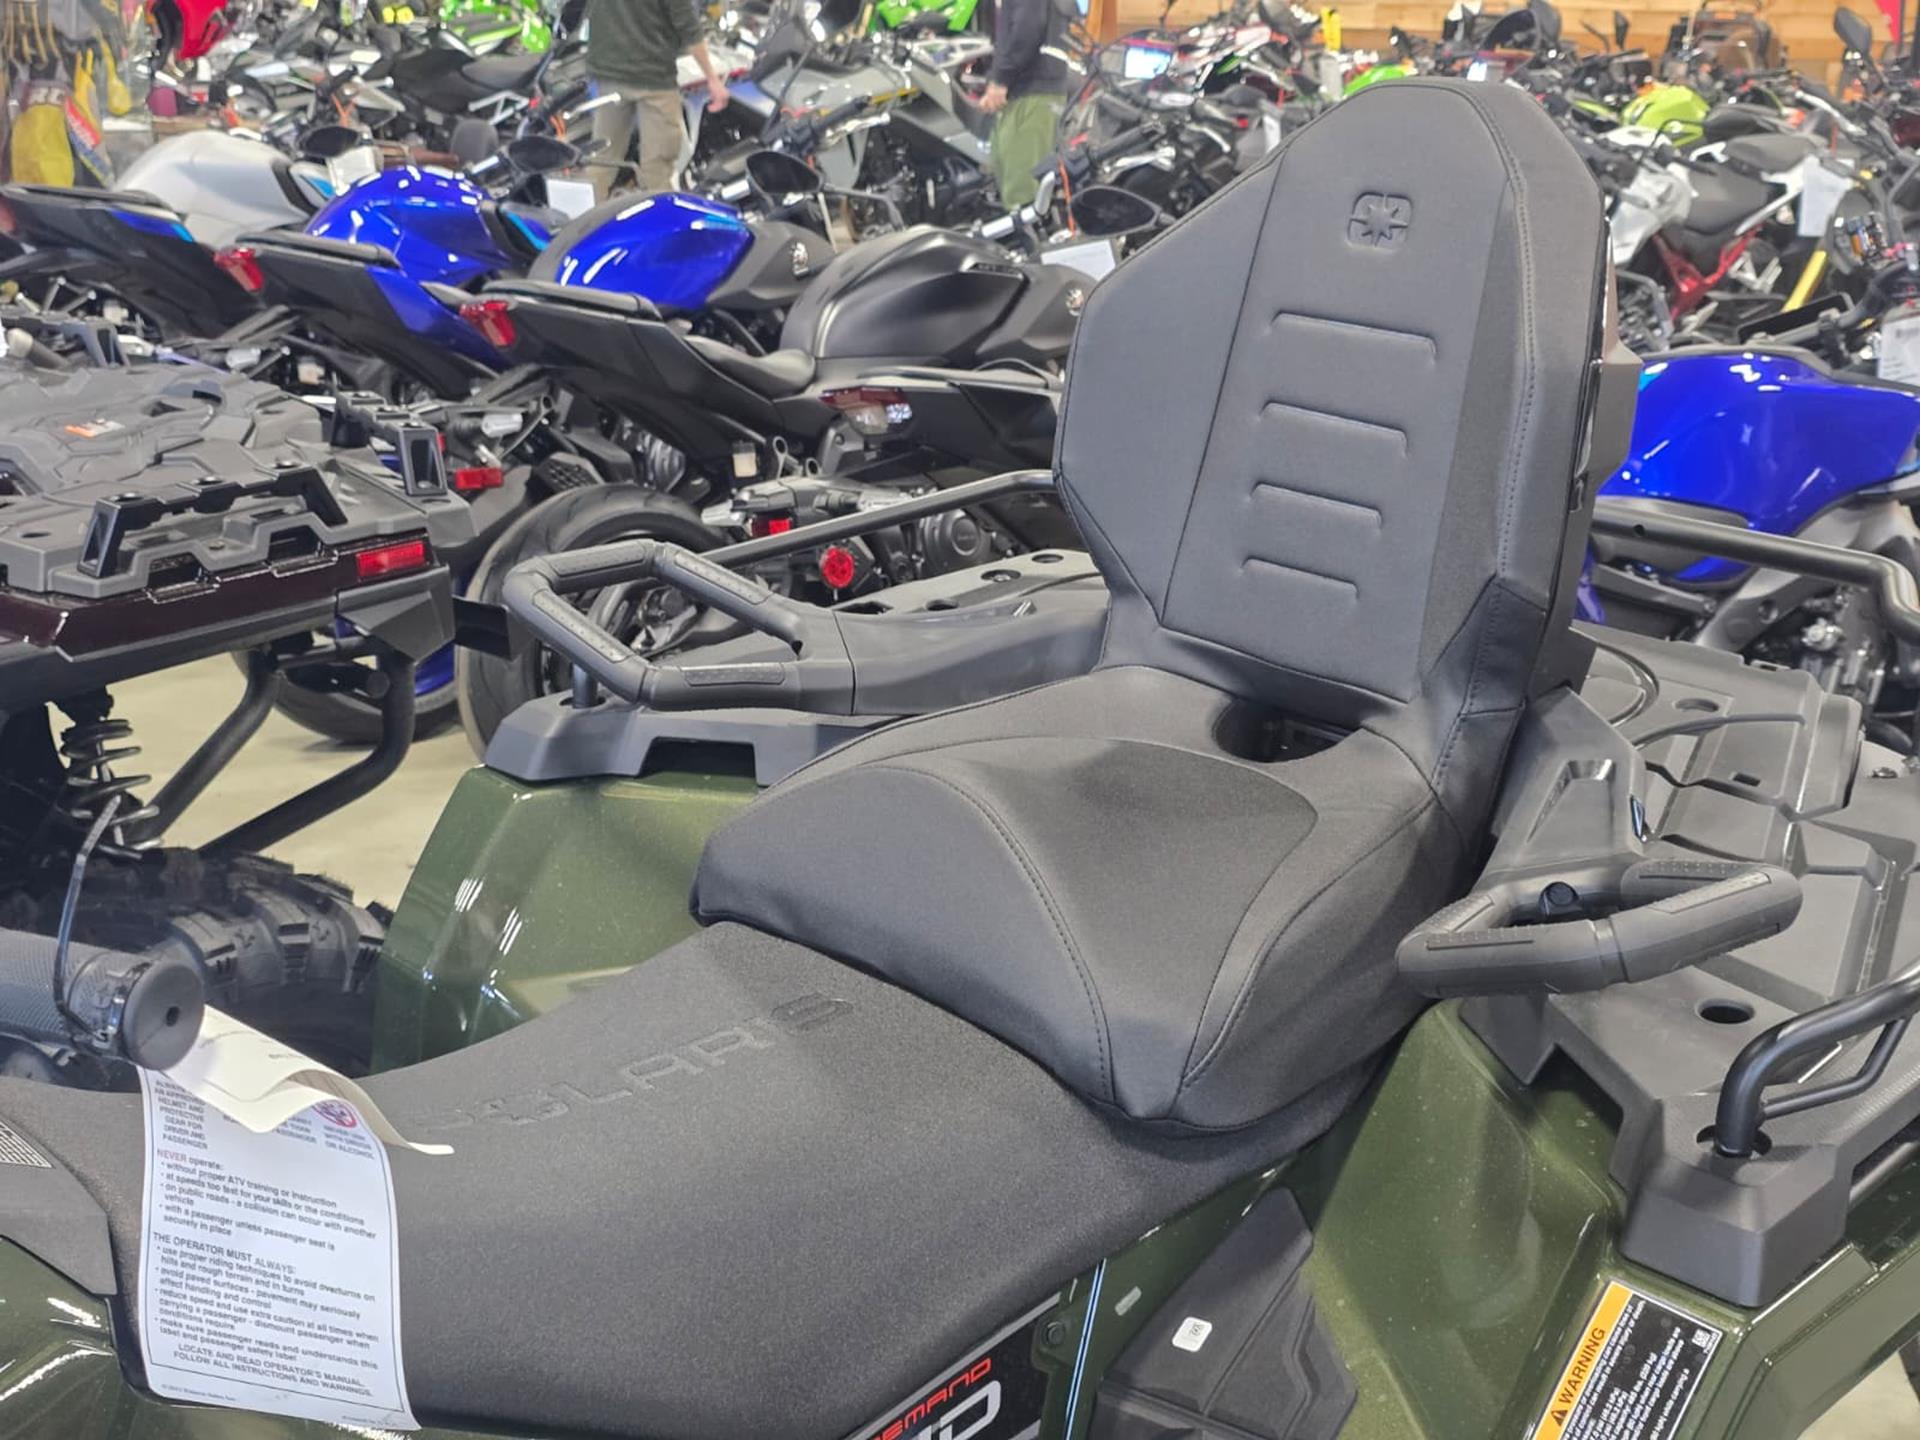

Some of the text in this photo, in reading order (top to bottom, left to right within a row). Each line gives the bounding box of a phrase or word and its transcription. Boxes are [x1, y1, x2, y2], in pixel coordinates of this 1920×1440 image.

[158, 1097, 186, 1108] HELMET
[160, 1106, 203, 1121] PROTECTIVE
[164, 1125, 204, 1140] DRIVER AND
[165, 1115, 201, 1129] GEAR FOR
[163, 1133, 207, 1149] PASSENGER
[339, 1144, 374, 1158] ALCOHOL
[157, 1148, 222, 1171] NEVER operate:
[165, 1192, 193, 1205] vehicle
[166, 1172, 173, 1180] at
[176, 1175, 204, 1188] speeds
[207, 1181, 220, 1191] too
[222, 1184, 237, 1195] fast
[240, 1189, 250, 1198] for
[253, 1193, 269, 1204] your
[272, 1196, 291, 1207] skills
[304, 1205, 317, 1214] the
[320, 1209, 364, 1225] conditions
[167, 1162, 196, 1174] without
[198, 1170, 224, 1183] proper
[228, 1175, 244, 1185] ATV
[246, 1180, 278, 1195] training
[292, 1191, 336, 1207] instruction
[164, 1214, 230, 1236] securely in place
[166, 1183, 175, 1191] on
[178, 1185, 204, 1199] public
[206, 1192, 228, 1203] roads
[244, 1201, 278, 1215] collision
[280, 1210, 295, 1219] can
[298, 1215, 321, 1225] occur
[324, 1221, 341, 1230] with
[344, 1225, 376, 1239] another
[166, 1204, 181, 1213] with
[192, 1210, 232, 1227] passenger
[235, 1220, 261, 1232] unless
[264, 1227, 306, 1245] passenger
[309, 1238, 325, 1248] seat
[327, 1242, 334, 1250] is
[154, 1232, 295, 1275] THE OPERATOR MUST ALWAYS:
[161, 1255, 303, 1296] hills and rough terrain and in turns
[162, 1246, 374, 1302] use proper riding techniques to avoid overturns on
[160, 1266, 359, 1320] avoid paved surfaces pavement may seriously
[160, 1277, 270, 1309] affect handling and control
[159, 1308, 234, 1330] conditions require
[160, 1288, 378, 1343] reduce speed and use extra caution at all times when
[160, 1298, 192, 1313] carrying
[203, 1308, 246, 1325] passenger
[255, 1319, 294, 1334] dismount
[297, 1329, 343, 1346] passenger
[346, 1338, 369, 1349] when
[160, 1326, 296, 1361] label and passenger safety label
[160, 1318, 377, 1370] make sure passenger reads and understands this
[178, 1343, 212, 1357] LOCATE
[216, 1351, 233, 1361] AND
[236, 1355, 260, 1366] READ
[263, 1360, 321, 1378] OPERATOR'S
[173, 1350, 210, 1365] FOLLOW
[213, 1358, 229, 1368] ALL
[232, 1362, 297, 1382] INSTRUCTIONS
[300, 1376, 318, 1386] AND
[1558, 1325, 1605, 1406] WARNING
[870, 1357, 992, 1440] EMAND
